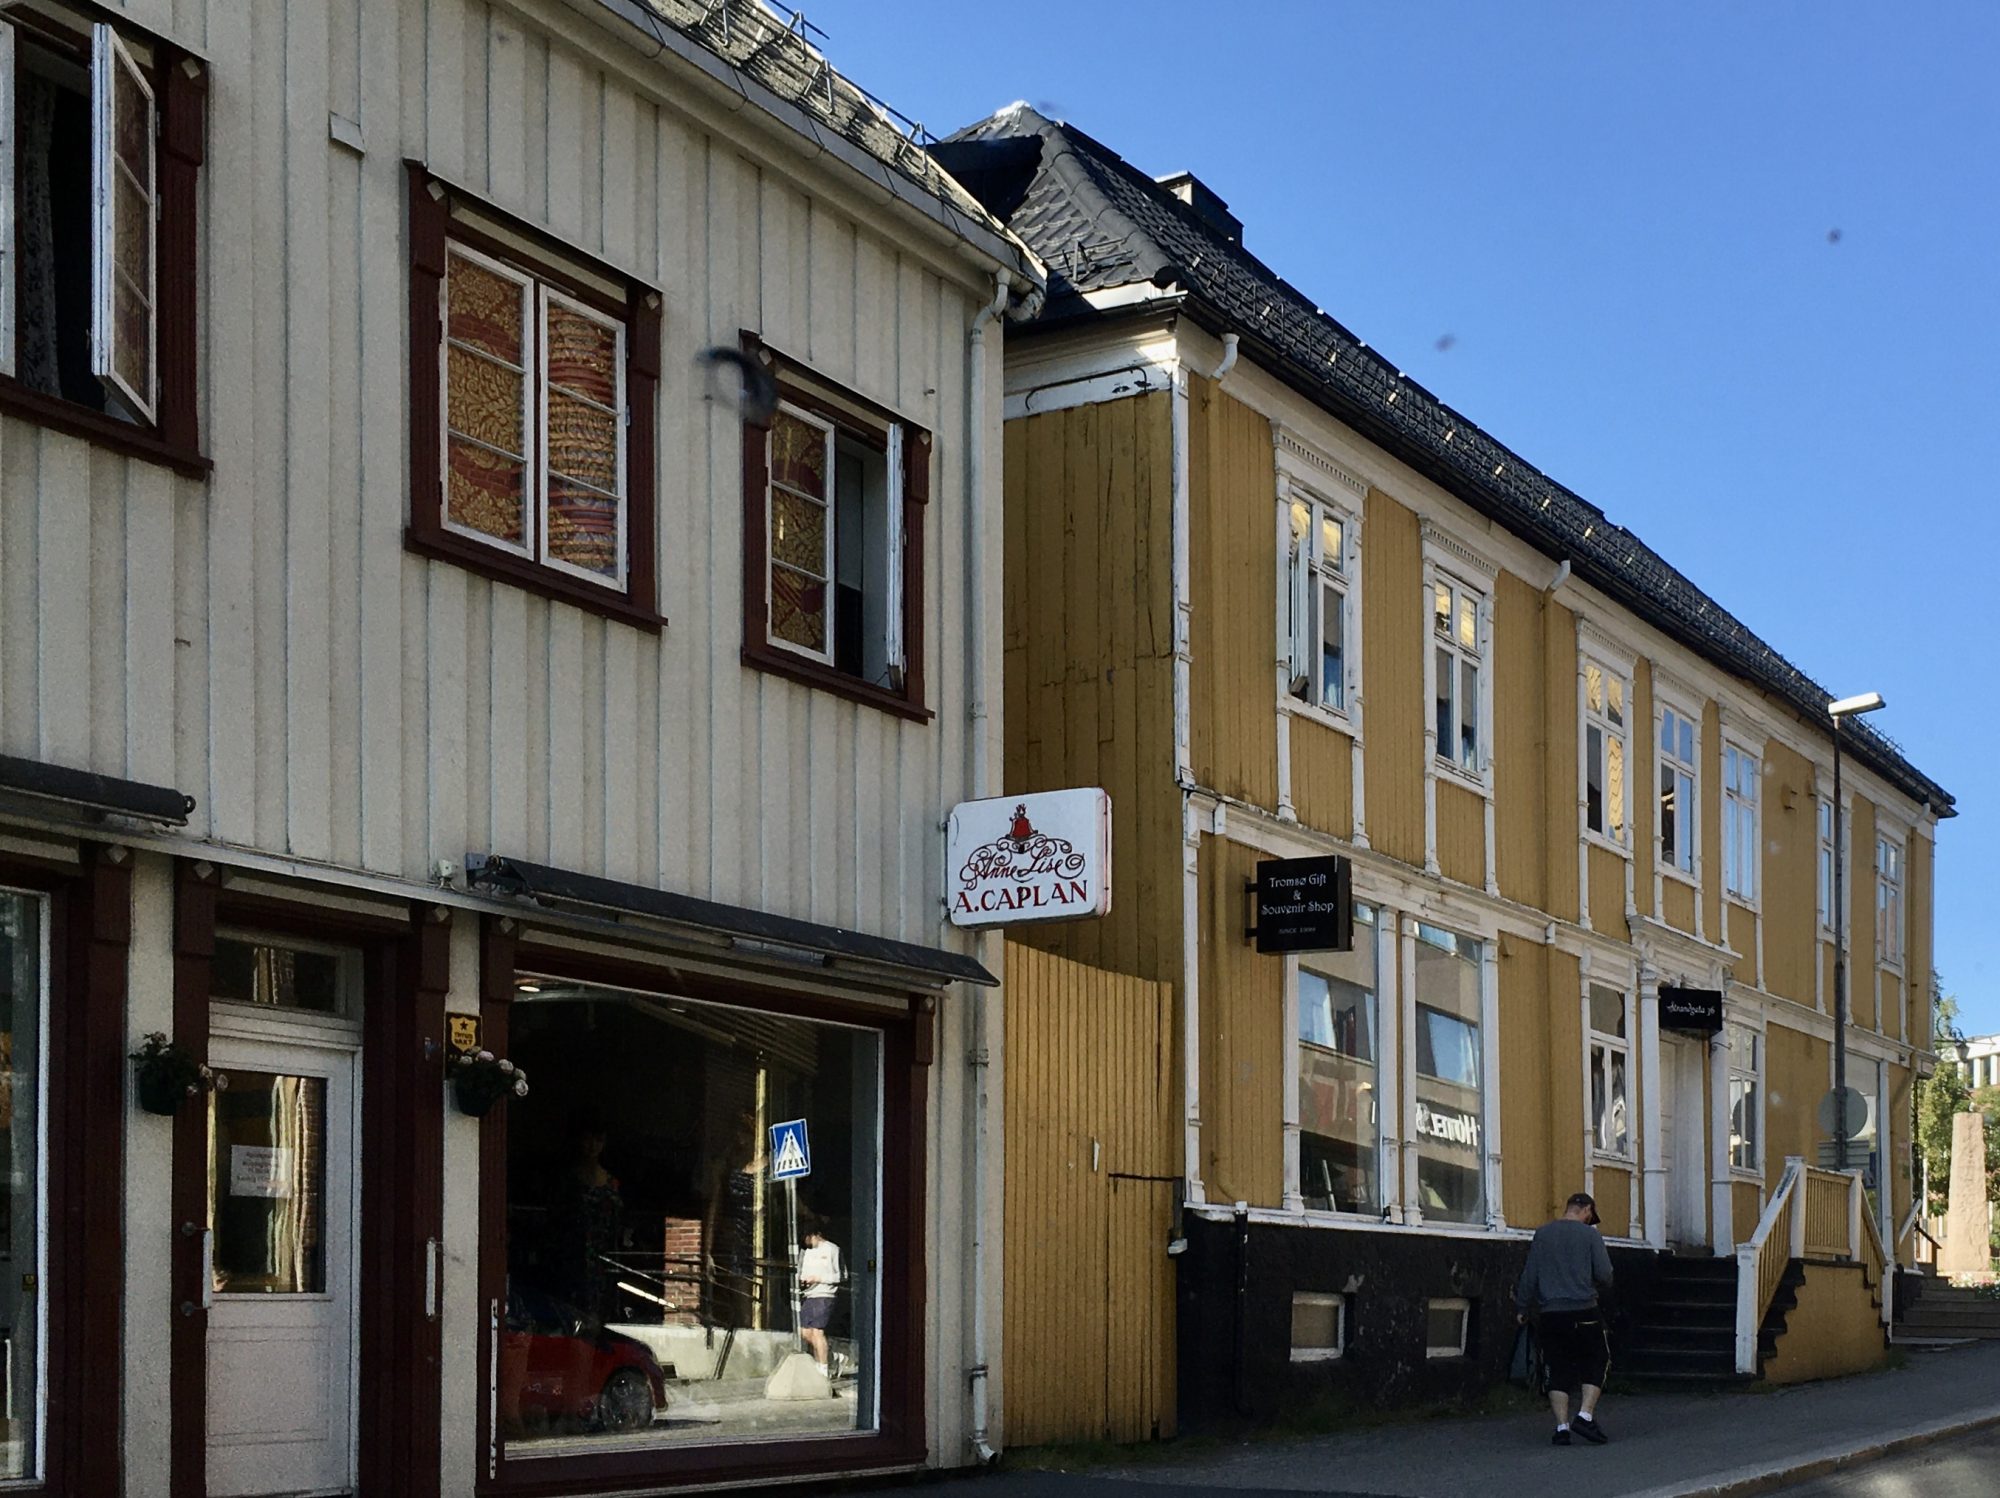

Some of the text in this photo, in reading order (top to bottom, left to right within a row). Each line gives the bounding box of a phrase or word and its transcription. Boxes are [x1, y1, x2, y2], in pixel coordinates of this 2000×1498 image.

[1270, 873, 1327, 888] Tromsø Gift
[1293, 889, 1302, 901] &
[1261, 901, 1335, 916] Souvenir Shop
